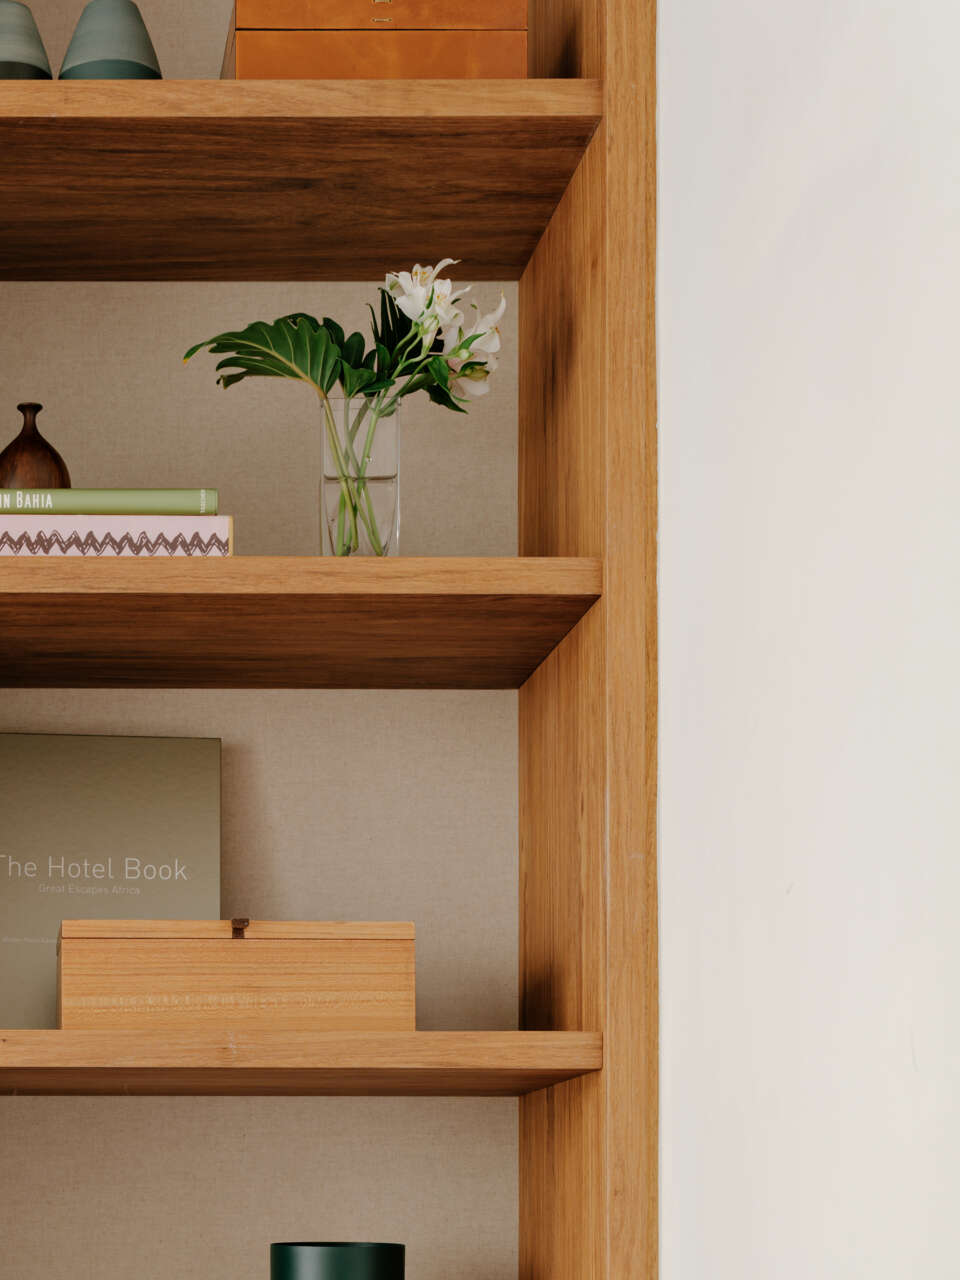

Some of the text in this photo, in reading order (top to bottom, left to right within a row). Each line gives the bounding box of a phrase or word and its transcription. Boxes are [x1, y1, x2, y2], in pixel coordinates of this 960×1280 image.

[0, 493, 10, 508] IN
[16, 491, 53, 508] BAHIA
[48, 855, 114, 879] Hotel
[124, 857, 188, 881] Book
[112, 885, 141, 896] Africa
